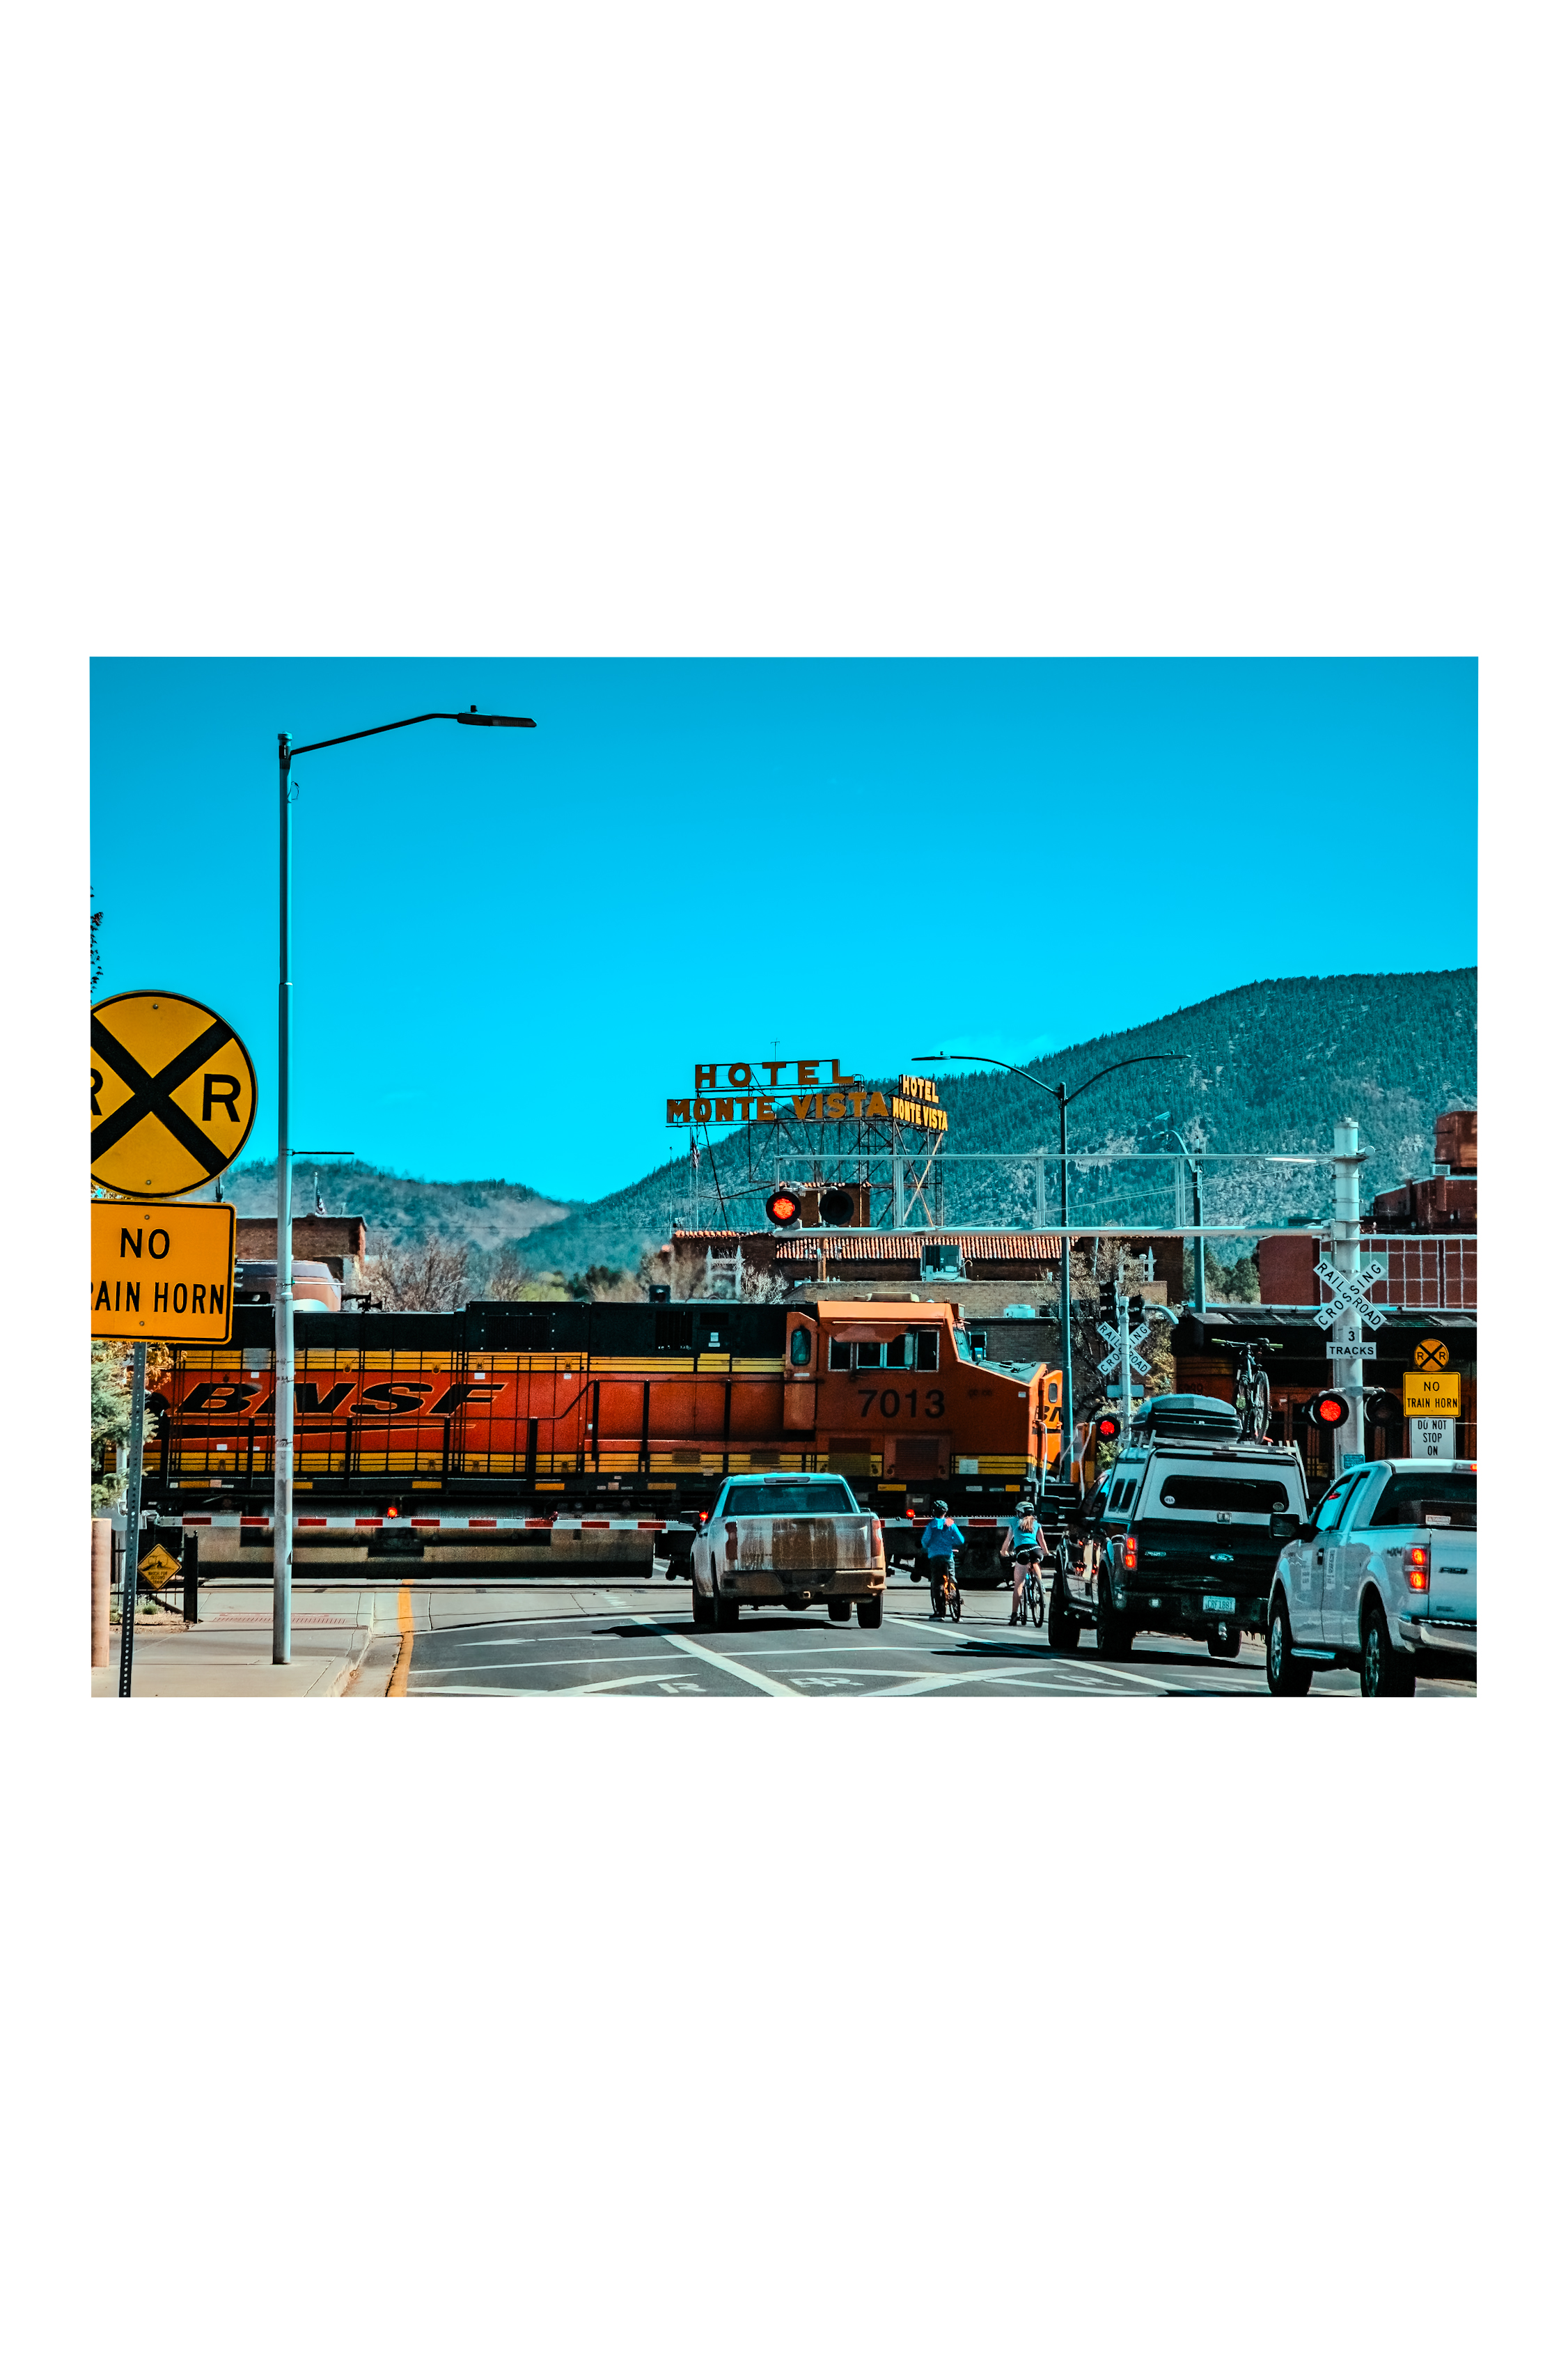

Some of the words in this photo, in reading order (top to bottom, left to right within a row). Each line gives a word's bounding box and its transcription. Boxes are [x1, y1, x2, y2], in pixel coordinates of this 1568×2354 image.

[695, 1059, 854, 1089] HOTEL
[902, 1073, 939, 1104] HOTEL
[202, 1073, 241, 1123] R
[666, 1095, 776, 1123] MONTE
[791, 1091, 889, 1120] VISTA
[892, 1096, 922, 1125] MONTE
[923, 1105, 948, 1132] VISTA
[120, 1227, 170, 1260] NO
[91, 1281, 141, 1312] AIN
[153, 1281, 225, 1315] HORN
[1318, 1264, 1381, 1325] CROSSING
[1329, 1346, 1374, 1355] TRACKS
[1348, 1331, 1356, 1341] 3
[1417, 1352, 1425, 1360] R
[1439, 1351, 1446, 1360] R
[174, 1381, 508, 1417] BNSF
[1423, 1381, 1440, 1392] NO
[857, 1389, 946, 1419] 7013
[1407, 1398, 1430, 1408] TRAIN
[1435, 1398, 1457, 1408] HORN
[1418, 1420, 1428, 1430] DO
[1432, 1420, 1447, 1430] NOT
[1422, 1433, 1442, 1442] STOP
[1427, 1446, 1438, 1456] ON
